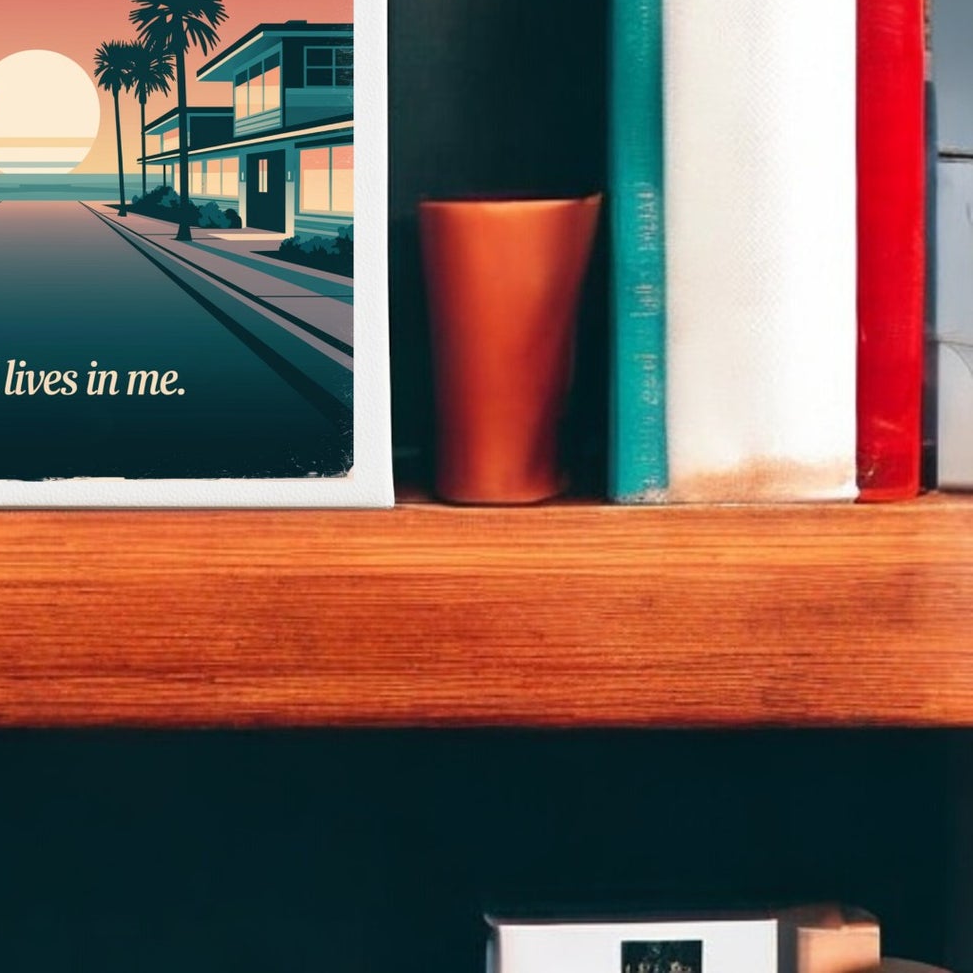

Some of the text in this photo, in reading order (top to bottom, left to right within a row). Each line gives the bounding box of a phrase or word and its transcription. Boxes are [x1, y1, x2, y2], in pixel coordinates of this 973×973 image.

[4, 359, 78, 396] lives
[86, 360, 119, 395] in
[126, 370, 185, 396] me.
